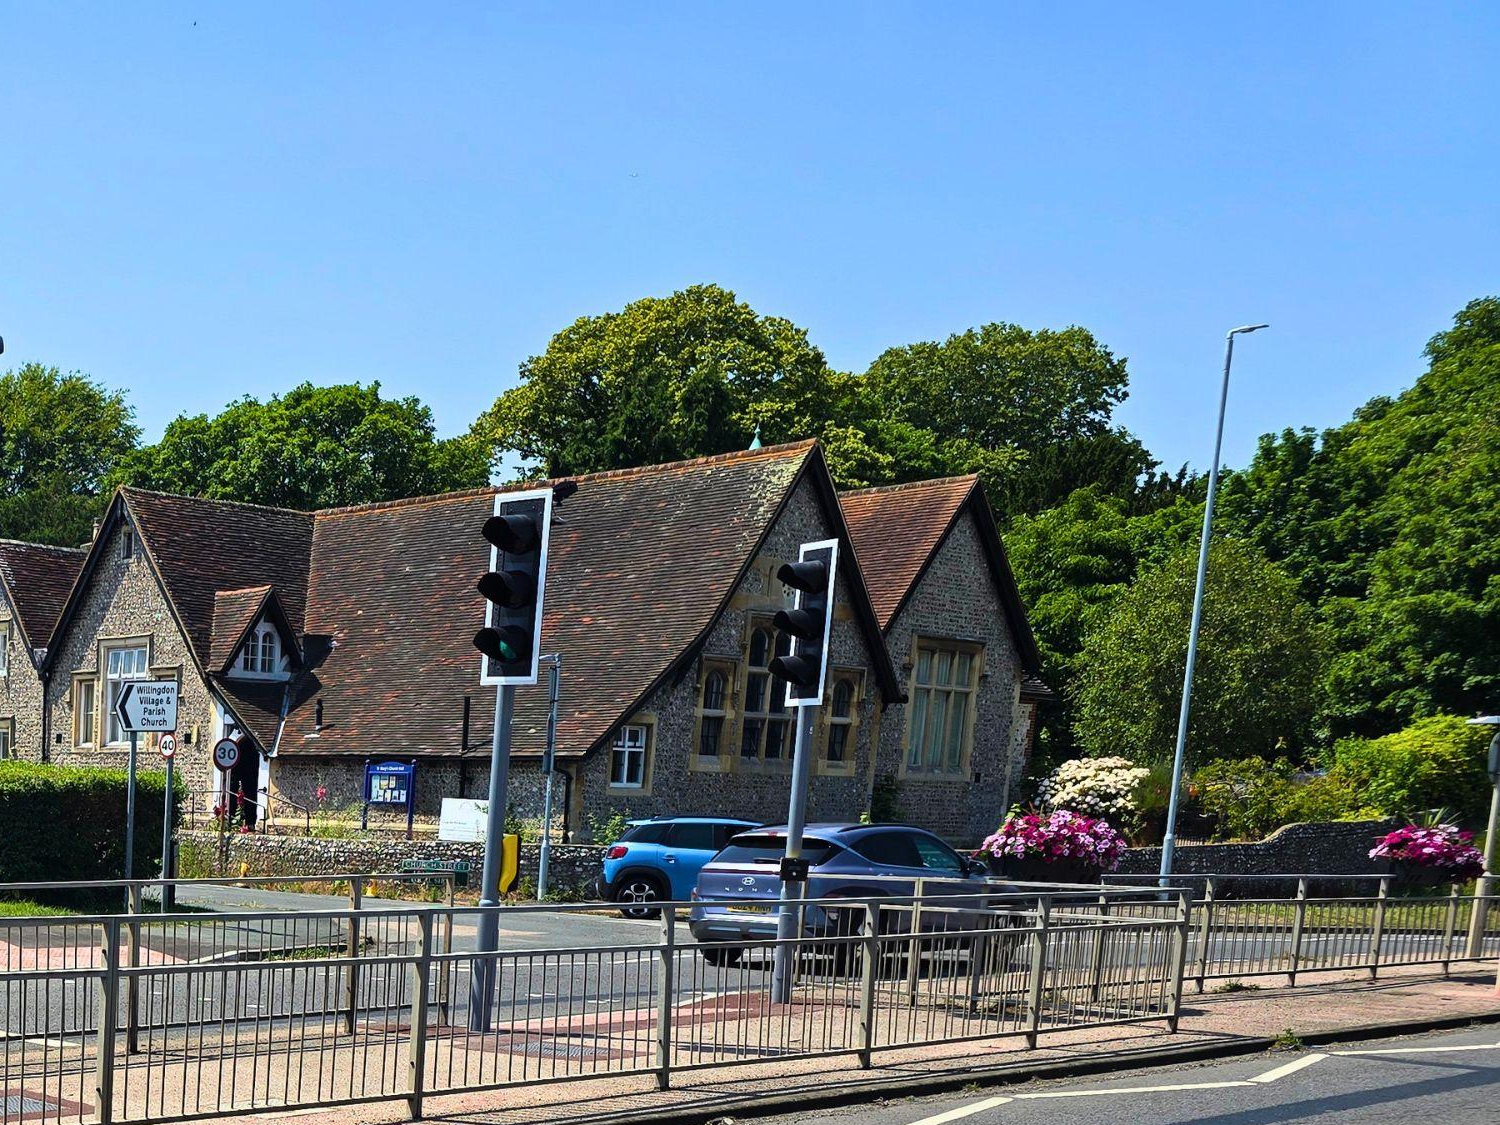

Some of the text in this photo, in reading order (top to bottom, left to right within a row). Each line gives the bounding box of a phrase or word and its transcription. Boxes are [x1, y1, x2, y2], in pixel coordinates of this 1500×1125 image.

[136, 685, 175, 696] Willingdon
[139, 696, 171, 706] Village &
[143, 706, 166, 716] Parish
[140, 717, 168, 727] Church
[161, 740, 175, 751] 40
[217, 747, 237, 761] 30
[404, 861, 467, 871] CHURCH STREET
